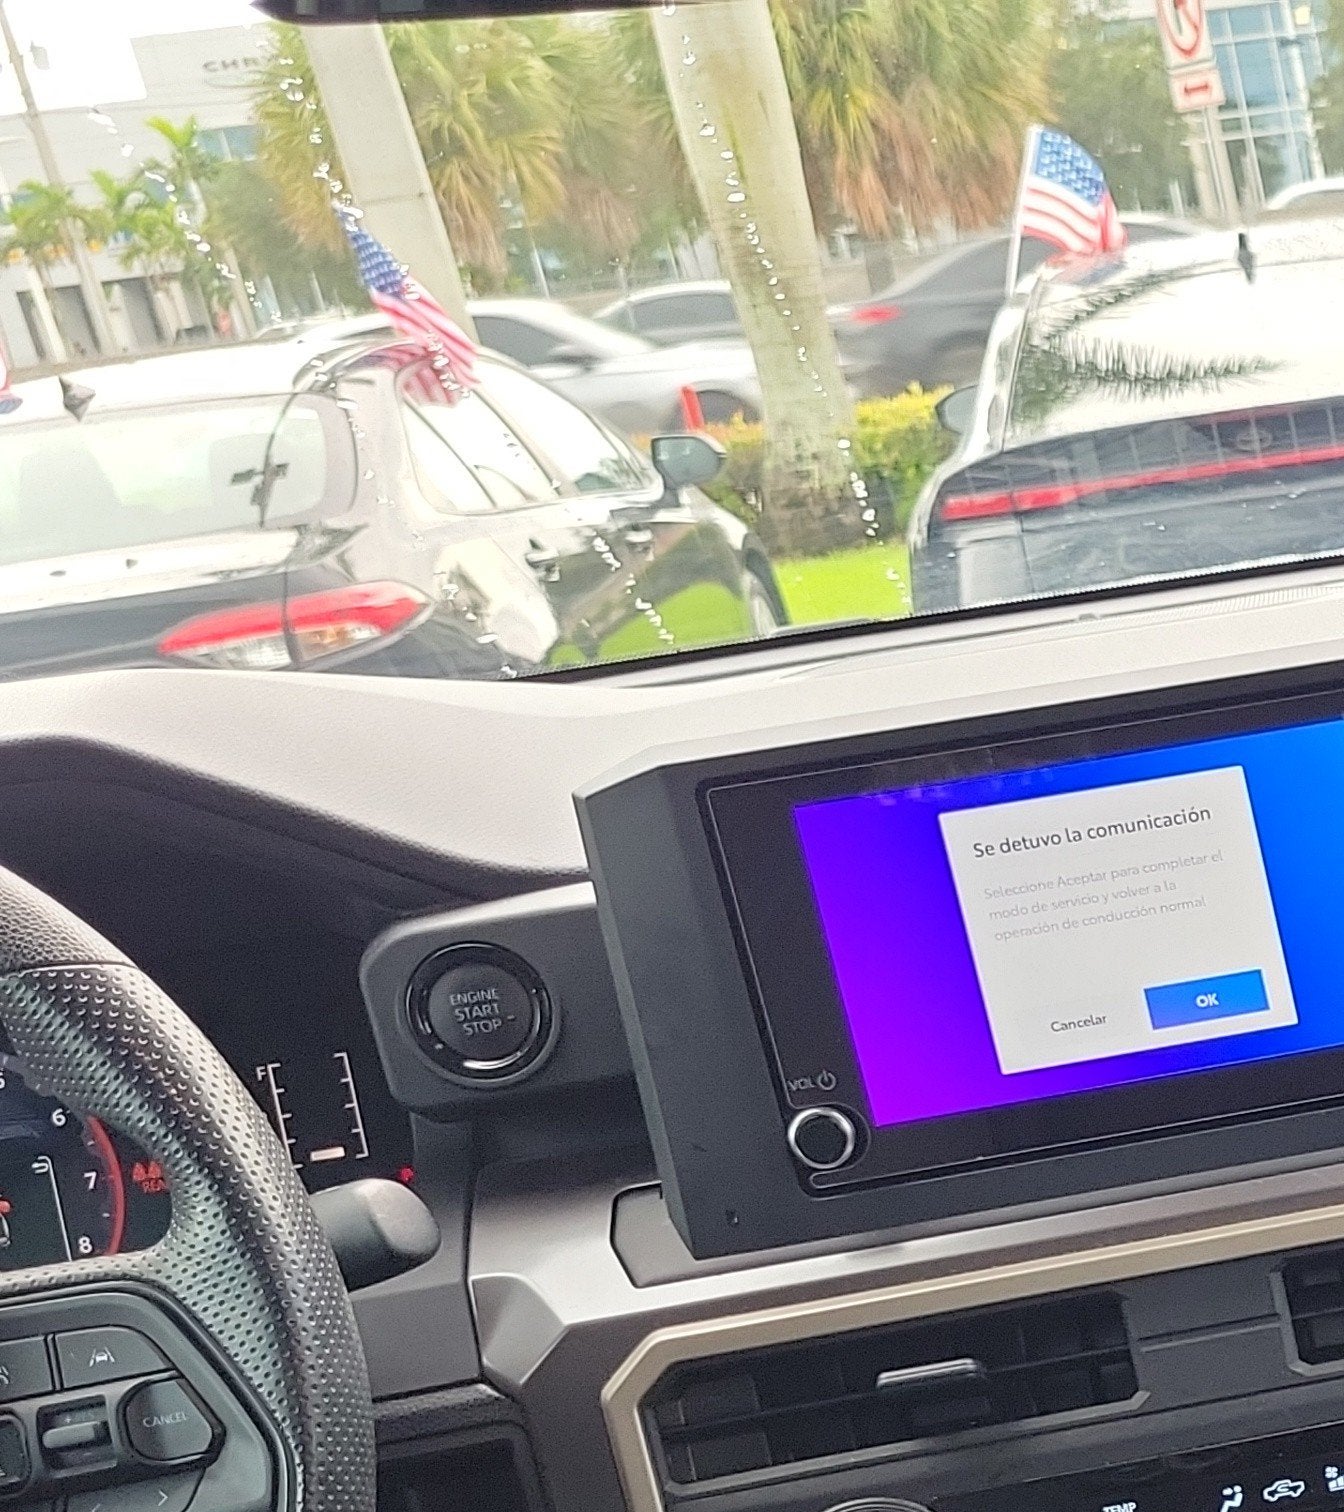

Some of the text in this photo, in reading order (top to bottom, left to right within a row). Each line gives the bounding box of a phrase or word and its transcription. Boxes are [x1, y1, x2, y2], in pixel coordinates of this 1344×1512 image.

[973, 806, 1212, 858] Se detuvo la comunicación
[984, 849, 1223, 900] Seleccione Aceptar para completar el
[989, 905, 1029, 921] modo
[1031, 899, 1049, 914] de
[1052, 892, 1100, 911] servicio
[1111, 885, 1151, 900] volver
[1164, 880, 1177, 892] la
[994, 897, 1207, 943] operación de conducción normal
[449, 988, 500, 1006] ENGINE
[1195, 993, 1219, 1008] OK
[454, 1003, 500, 1022] START
[462, 1018, 502, 1036] STOP
[1050, 1014, 1107, 1033] Cancelar
[256, 1066, 267, 1081] F
[786, 1077, 816, 1091] VOL
[52, 1110, 66, 1126] 6
[84, 1172, 97, 1190] 7
[78, 1236, 93, 1253] 8
[142, 1411, 188, 1428] CANCEL
